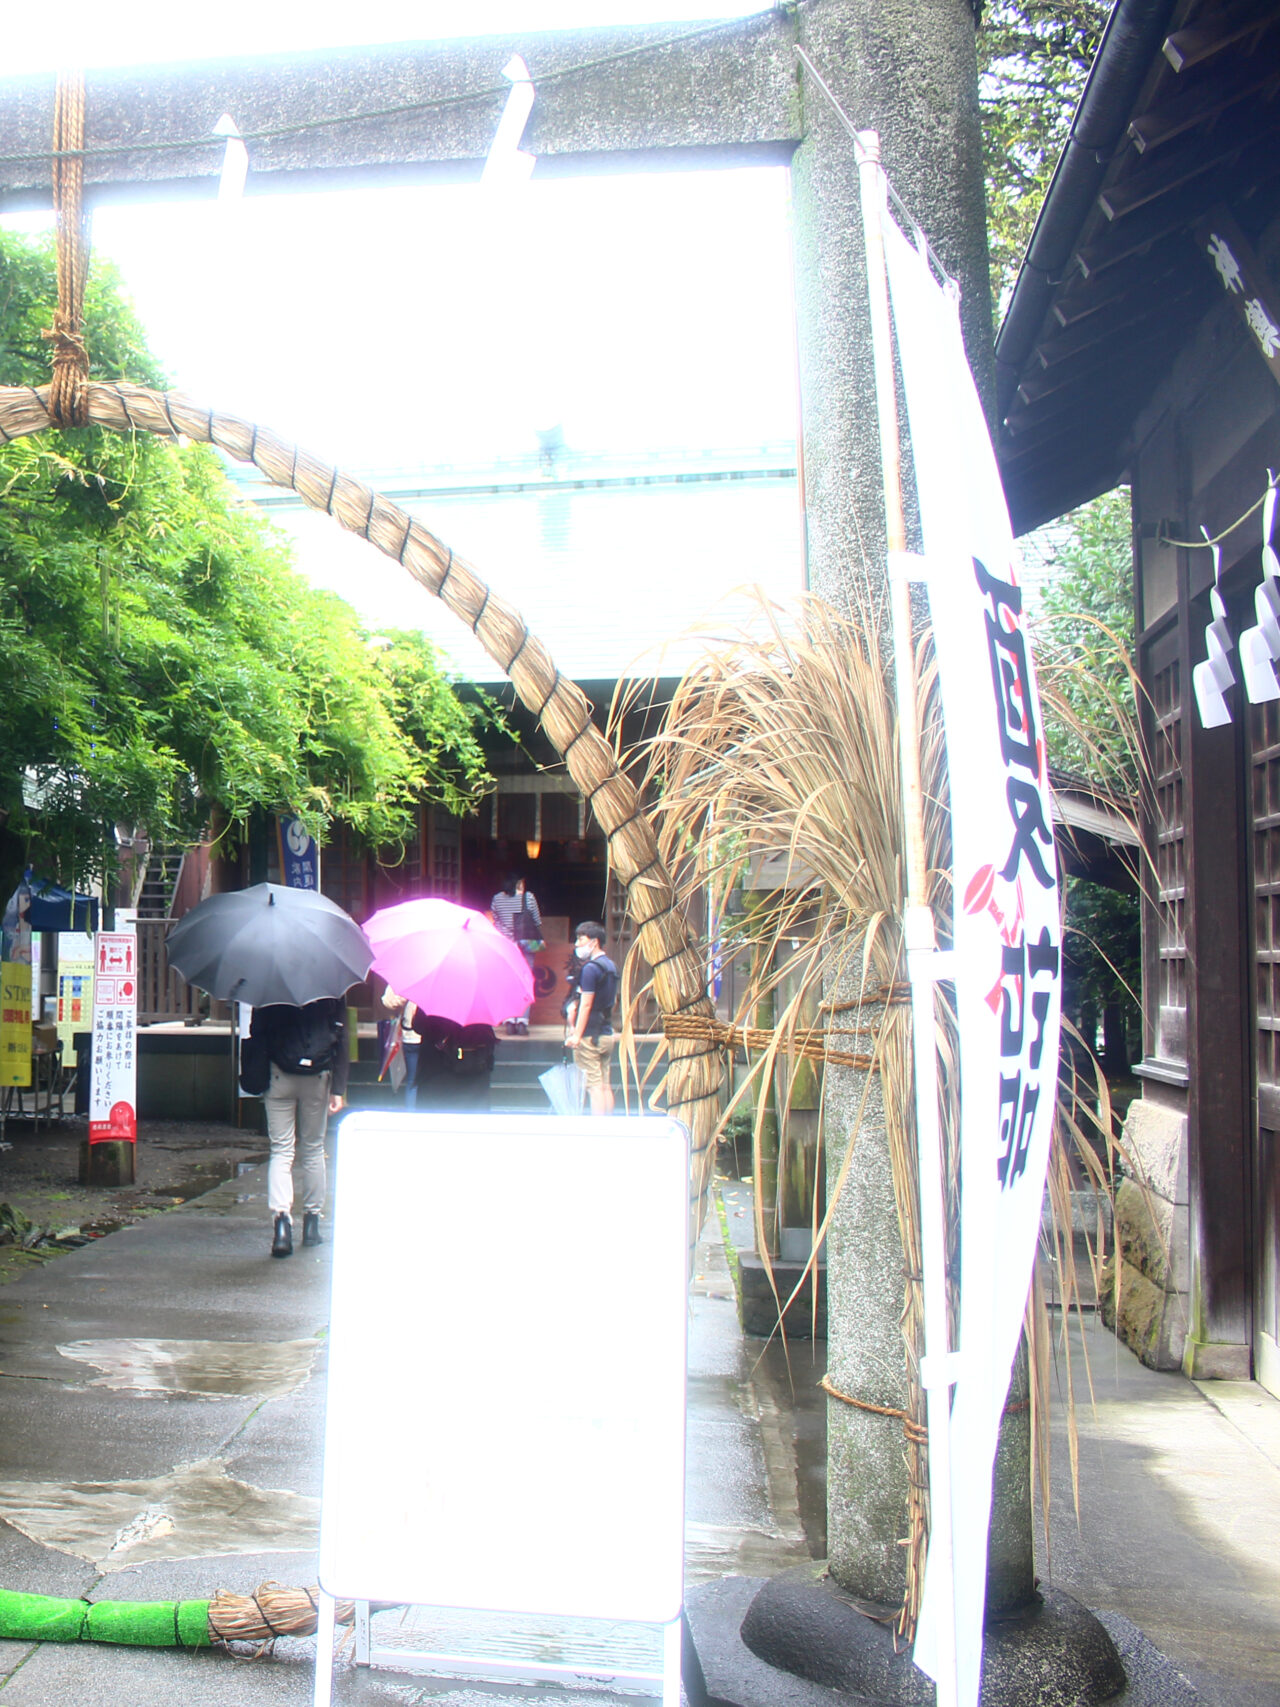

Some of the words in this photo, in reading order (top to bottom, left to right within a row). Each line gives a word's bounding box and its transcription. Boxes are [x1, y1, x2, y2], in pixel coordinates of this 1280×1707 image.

[94, 1010, 105, 1107] ご協力お願いします
